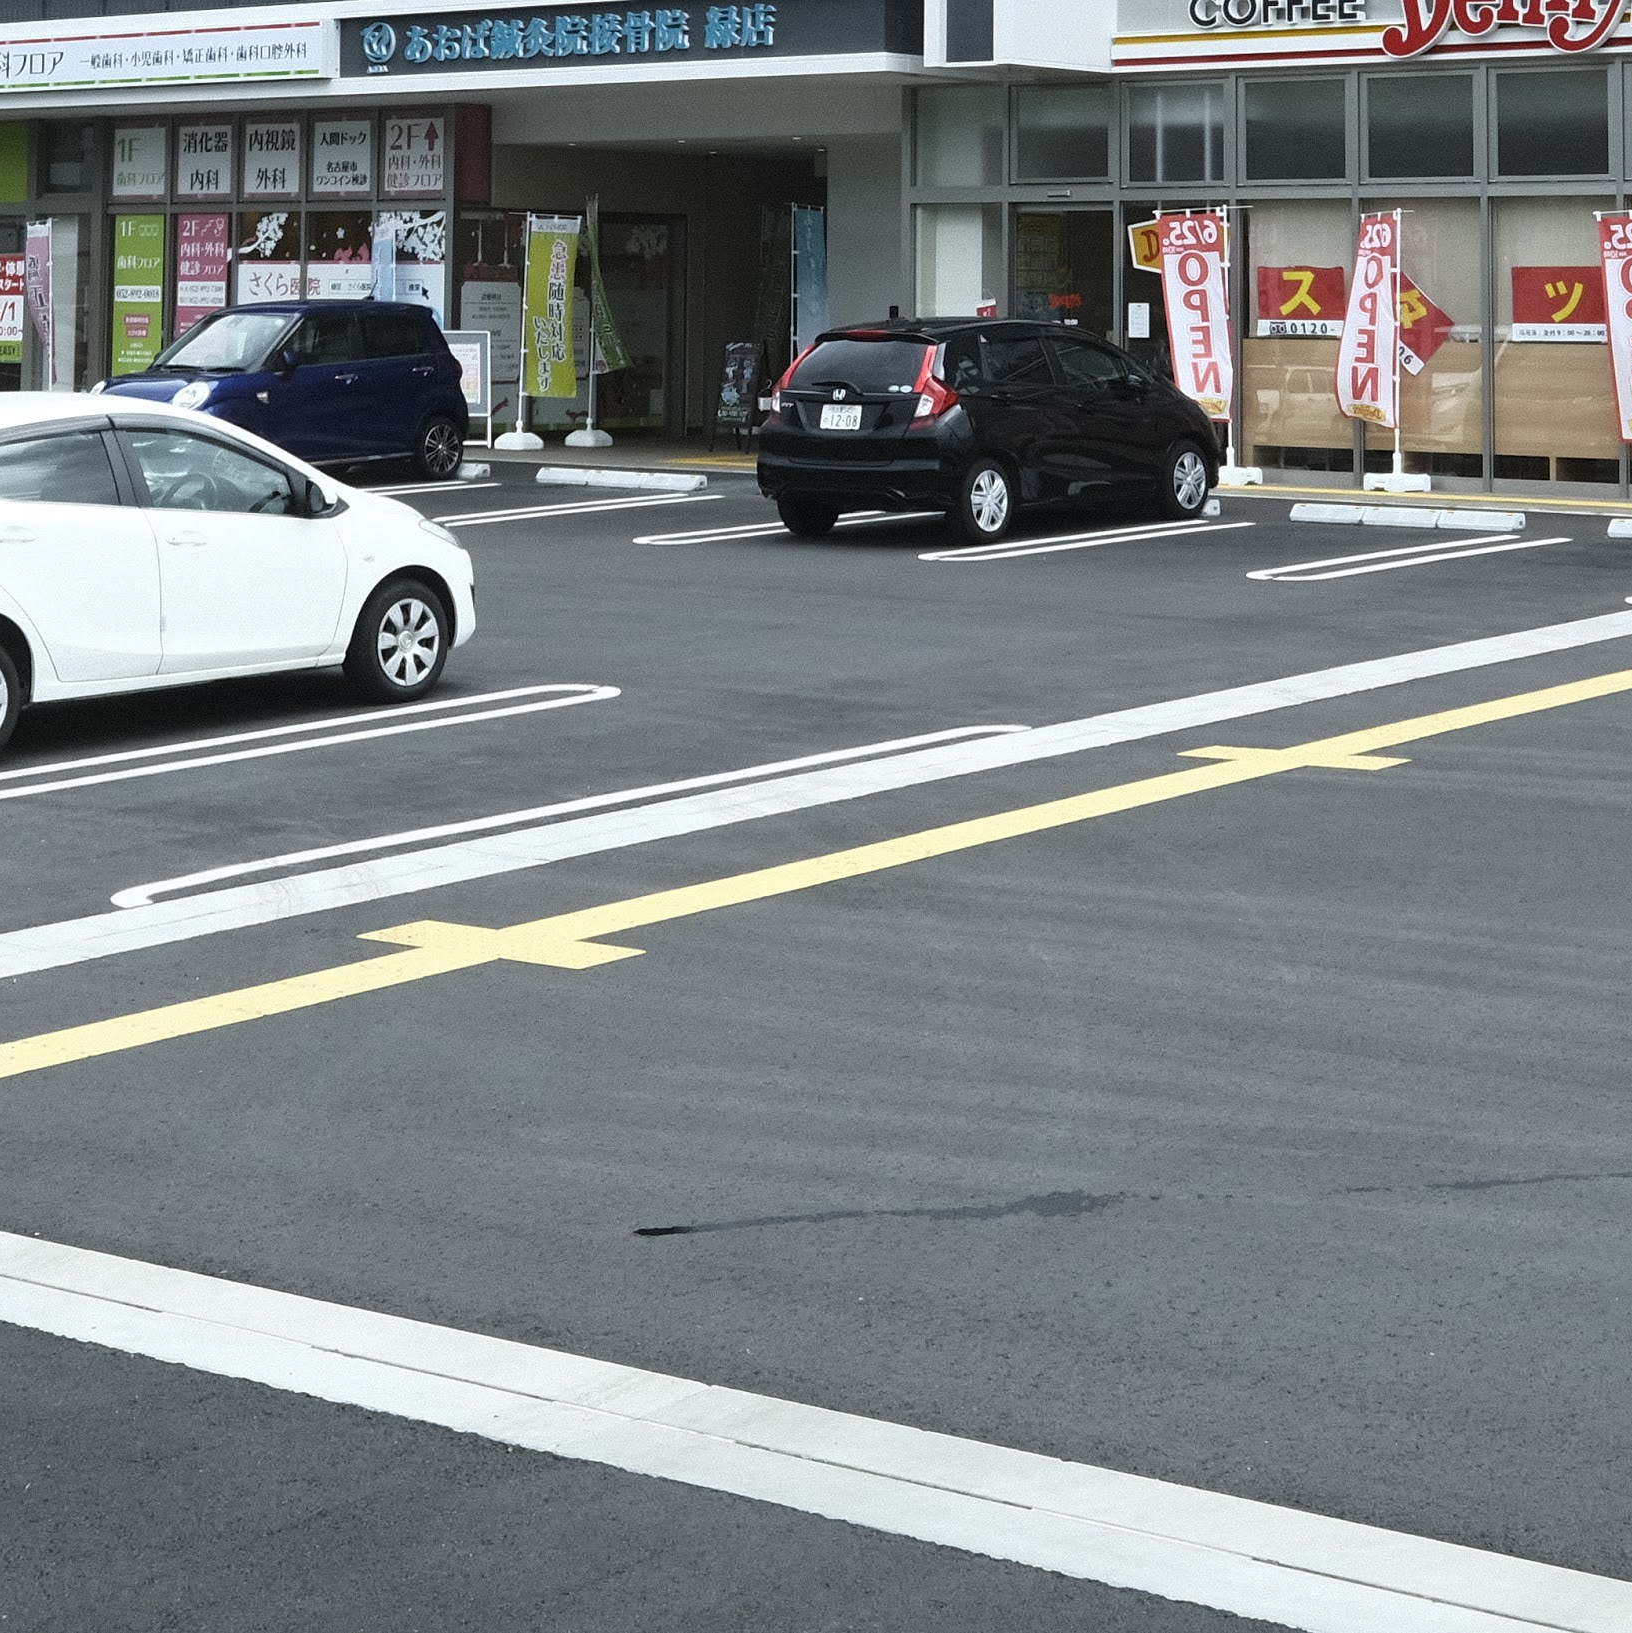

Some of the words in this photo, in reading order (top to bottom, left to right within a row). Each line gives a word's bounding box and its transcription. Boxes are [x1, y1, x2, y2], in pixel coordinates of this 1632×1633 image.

[404, 8, 690, 64] あおば鍼灸院接骨院
[704, 3, 776, 49] 緑店
[183, 131, 228, 154] 消化器
[248, 122, 296, 152] 内視鏡
[320, 131, 366, 146] 人間ドック
[390, 124, 422, 151] 2F
[117, 137, 141, 162] 1F
[326, 161, 358, 173] 名古屋市
[388, 154, 441, 170] 内科・外科
[190, 169, 219, 191] 内科
[255, 167, 287, 190] 外科
[387, 173, 442, 188] 健診フロア
[120, 220, 136, 237] 1F
[182, 220, 200, 237] 2F
[180, 242, 224, 257] 内科・外科
[117, 255, 160, 269] 歯科フロア
[180, 261, 224, 275] 健診フロア
[249, 271, 321, 296] さくら医院
[1279, 271, 1322, 316] ス
[533, 316, 552, 392] いたします
